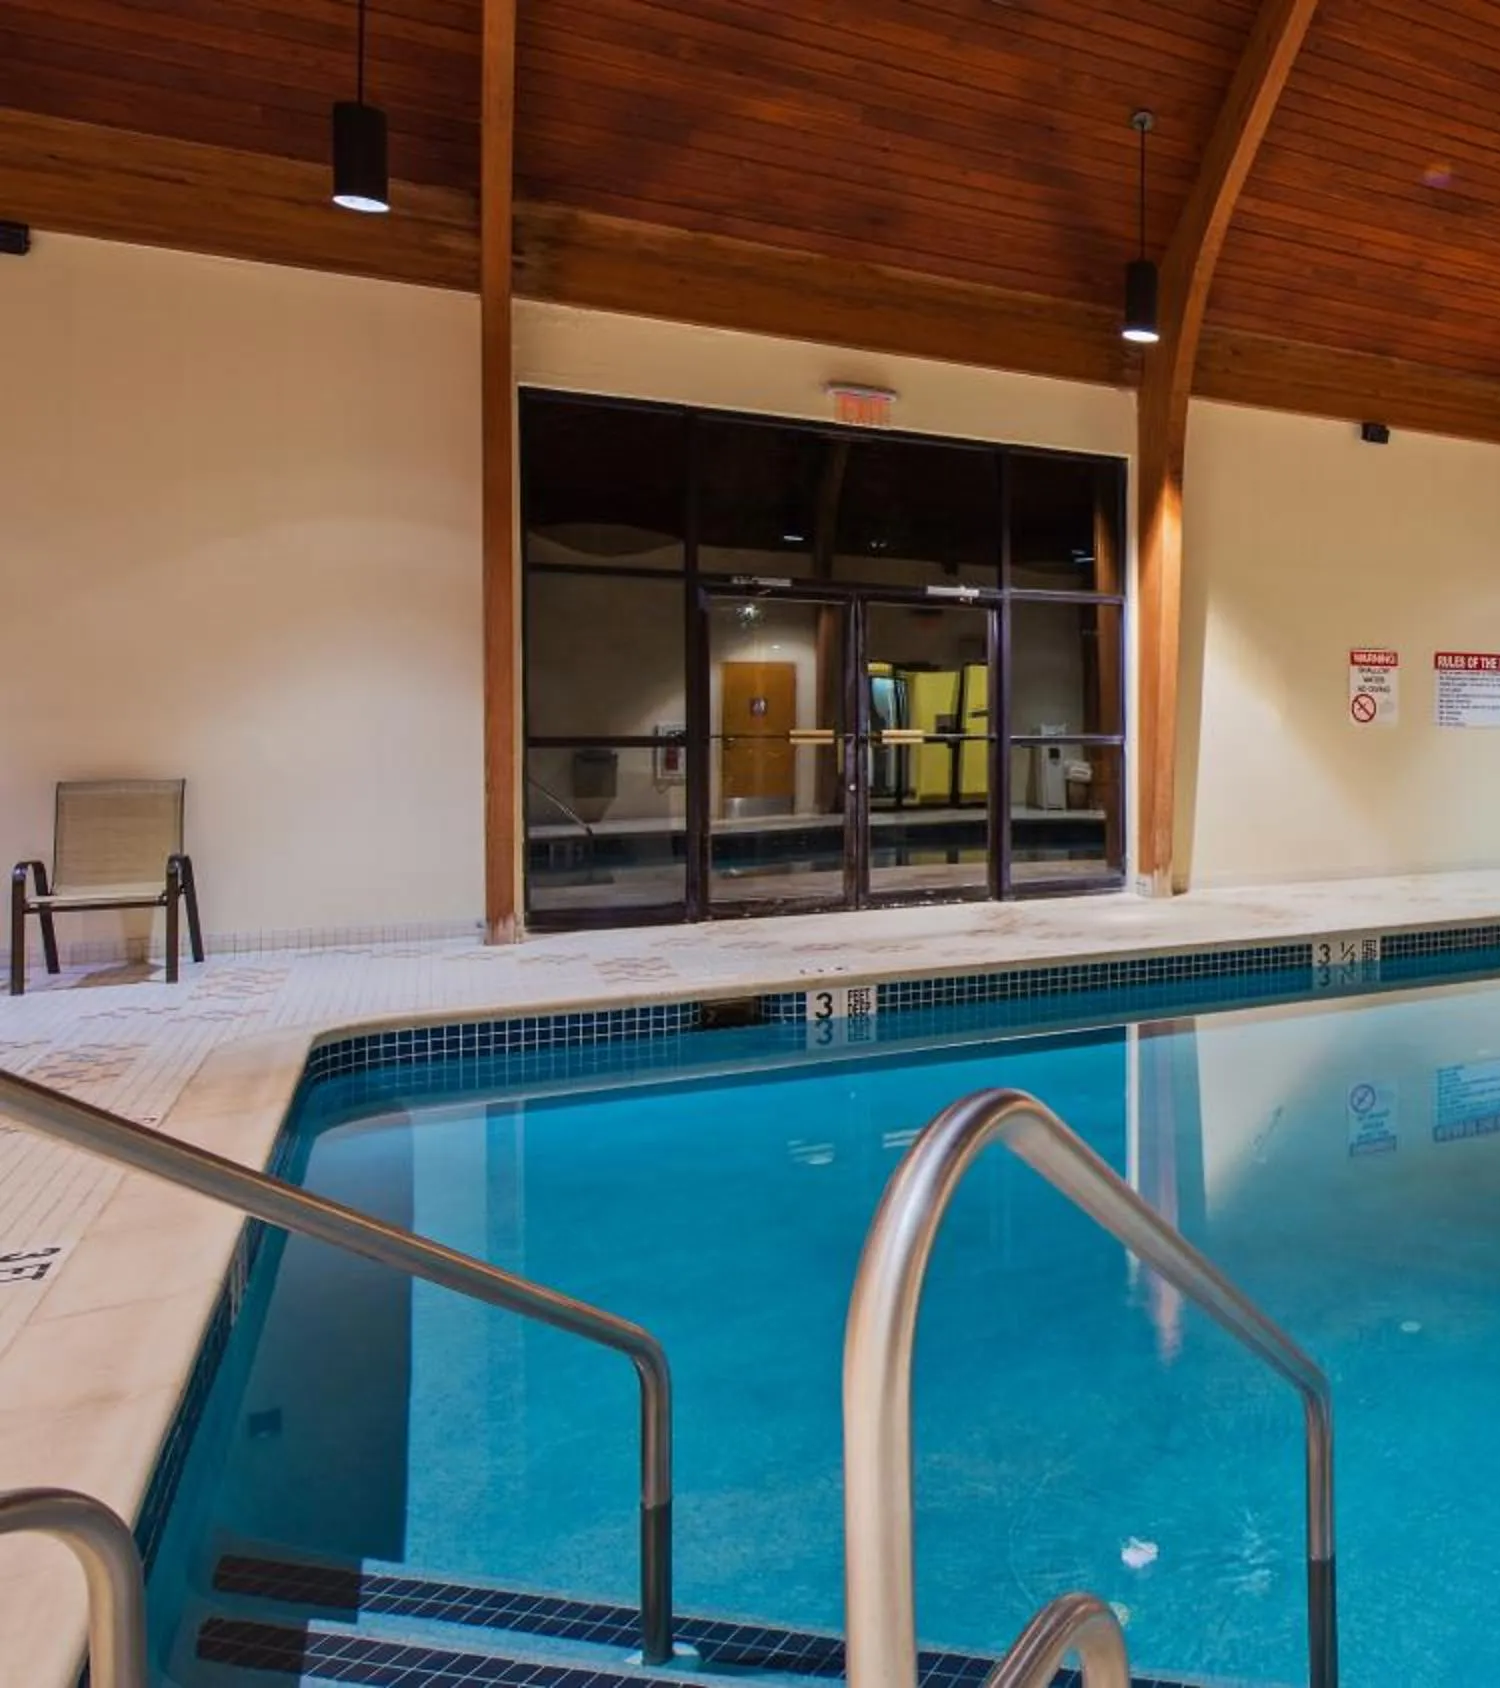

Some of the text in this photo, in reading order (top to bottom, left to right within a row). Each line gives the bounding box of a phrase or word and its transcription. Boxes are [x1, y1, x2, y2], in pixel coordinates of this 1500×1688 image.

[1437, 655, 1466, 670] RULES
[1467, 655, 1479, 670] OF
[1480, 656, 1498, 670] THE
[1317, 943, 1331, 965] 3
[815, 991, 834, 1019] 3
